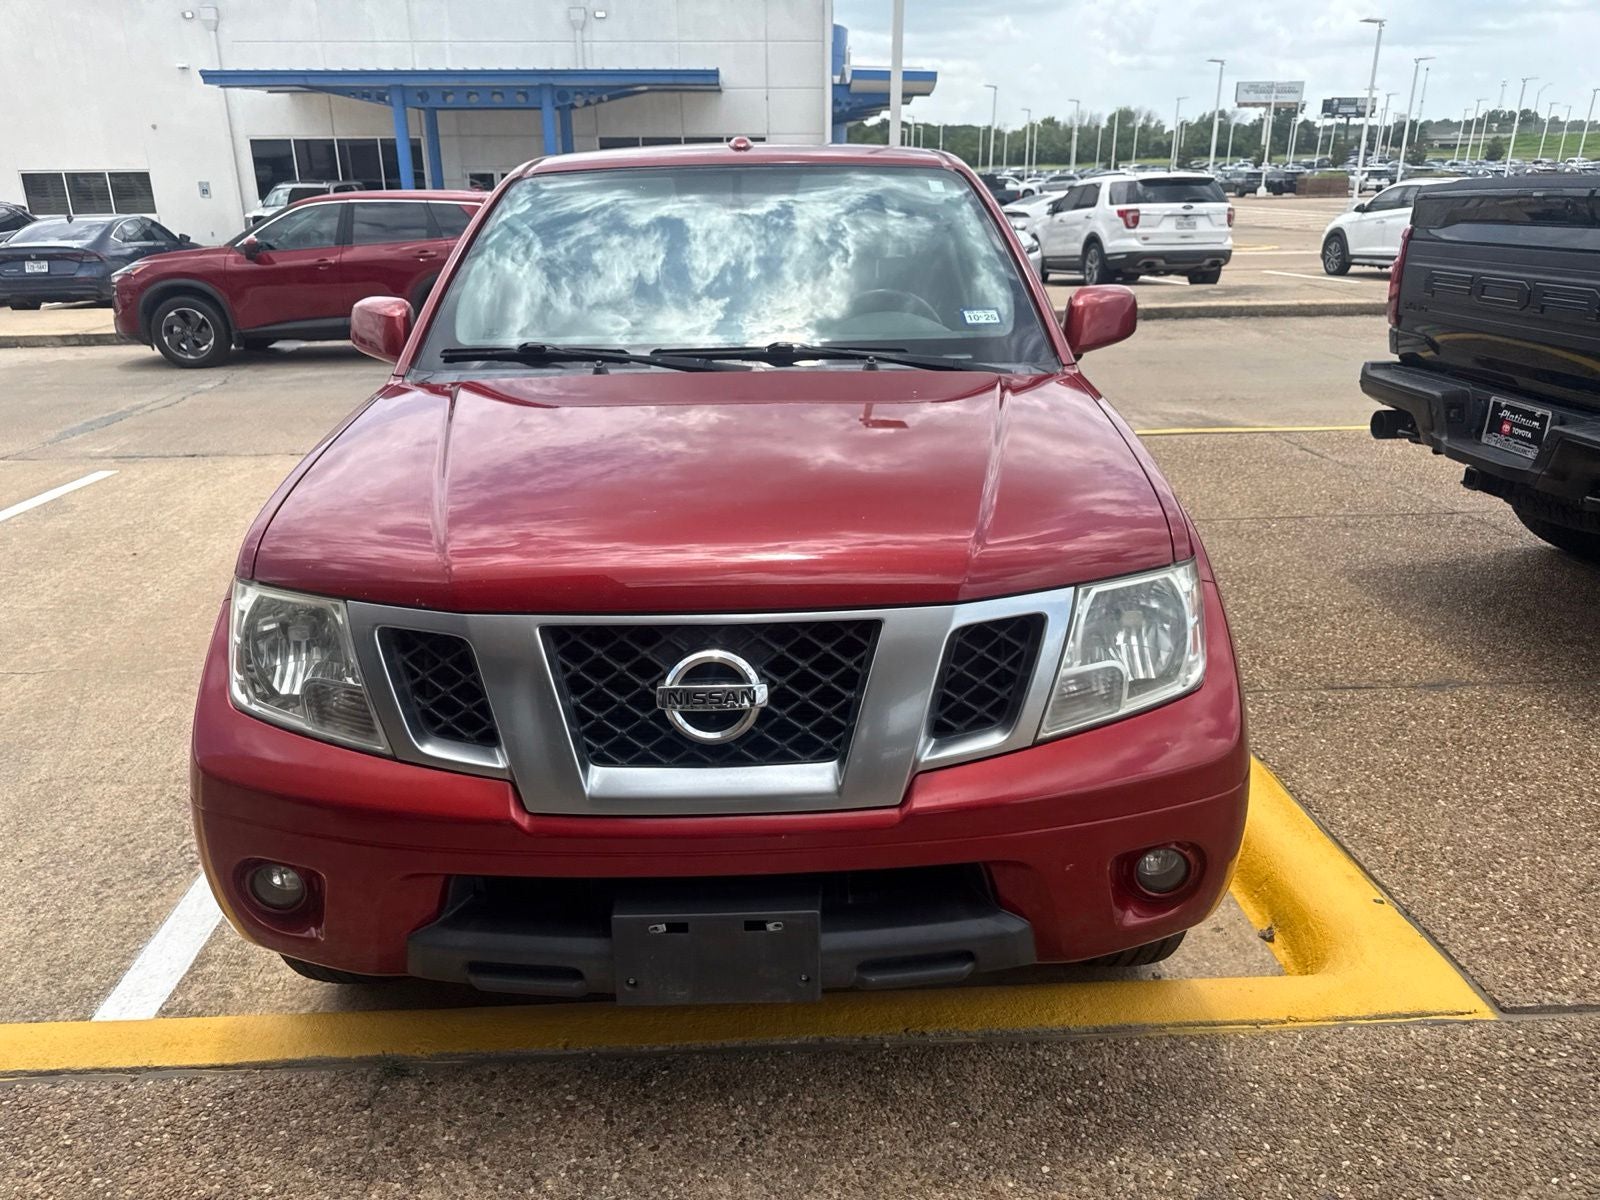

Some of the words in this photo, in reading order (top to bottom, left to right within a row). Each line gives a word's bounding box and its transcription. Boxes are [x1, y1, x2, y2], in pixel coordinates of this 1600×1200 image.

[1498, 409, 1541, 430] Platinum
[1512, 427, 1532, 439] TOYOTA
[667, 689, 757, 705] NISSAN
